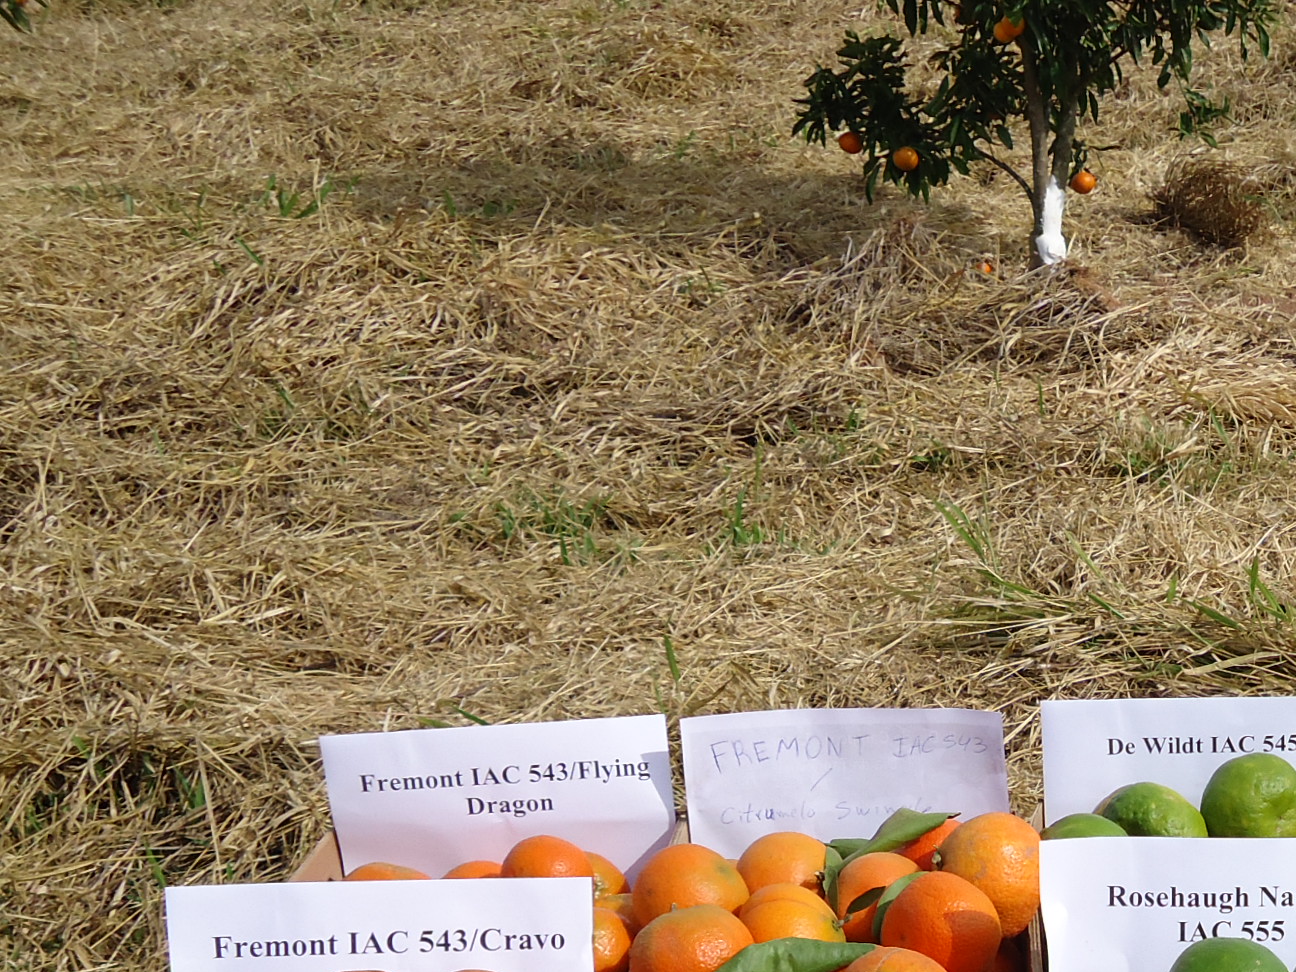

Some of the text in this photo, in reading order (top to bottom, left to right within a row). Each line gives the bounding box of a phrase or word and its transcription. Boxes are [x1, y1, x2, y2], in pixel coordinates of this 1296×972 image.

[710, 735, 870, 773] FREMONT
[1107, 737, 1135, 755] De
[1142, 737, 1203, 754] Wildt
[1212, 736, 1255, 753] IAC
[359, 757, 652, 792] Fremont IAC 543/Flying
[466, 792, 554, 817] Dragon
[1107, 885, 1249, 913] Rosehaugh
[213, 929, 566, 958] Fremont IAC 543/Cravo
[1178, 920, 1285, 942] IAC 555
